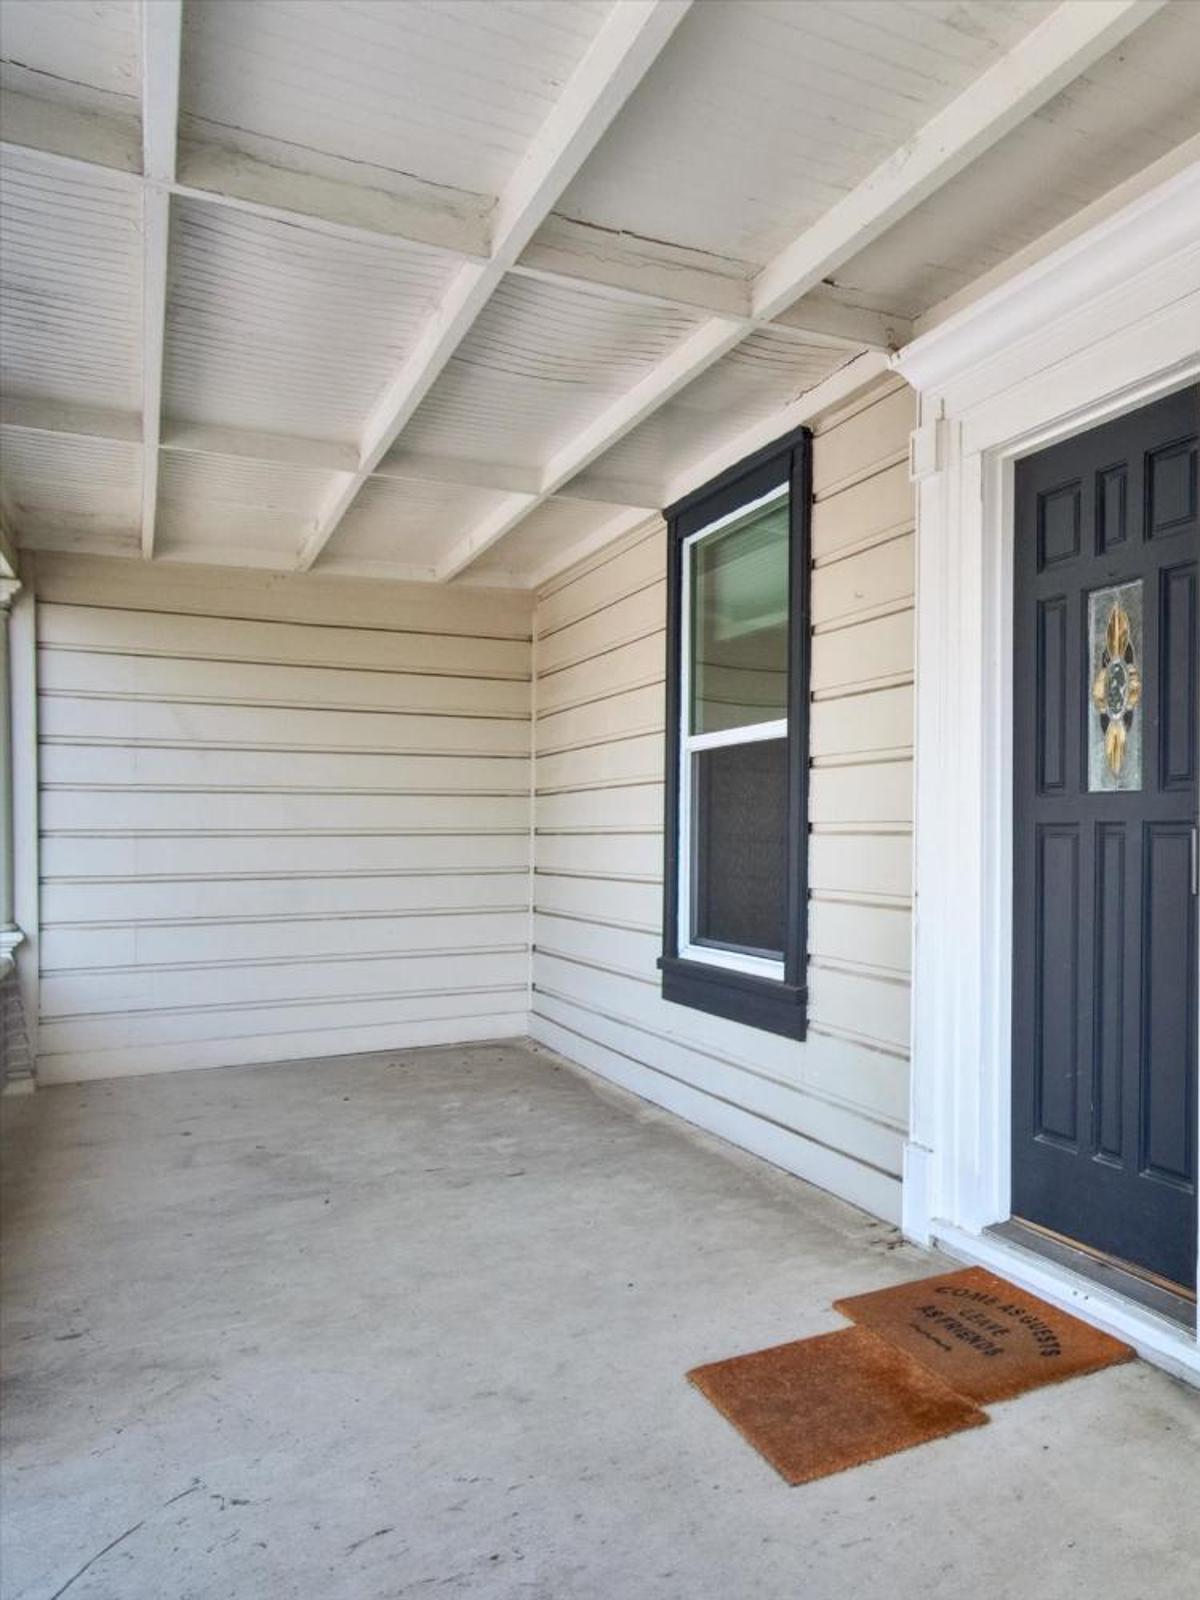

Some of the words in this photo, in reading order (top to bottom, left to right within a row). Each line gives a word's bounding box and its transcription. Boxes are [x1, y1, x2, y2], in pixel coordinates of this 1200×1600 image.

[917, 1305, 944, 1318] AS
[934, 1316, 1004, 1356] FRIENDS
[935, 1286, 999, 1305] COME
[998, 1304, 1026, 1316] AS
[1018, 1314, 1061, 1356] GUESTS
[959, 1308, 1010, 1336] LEAVE
